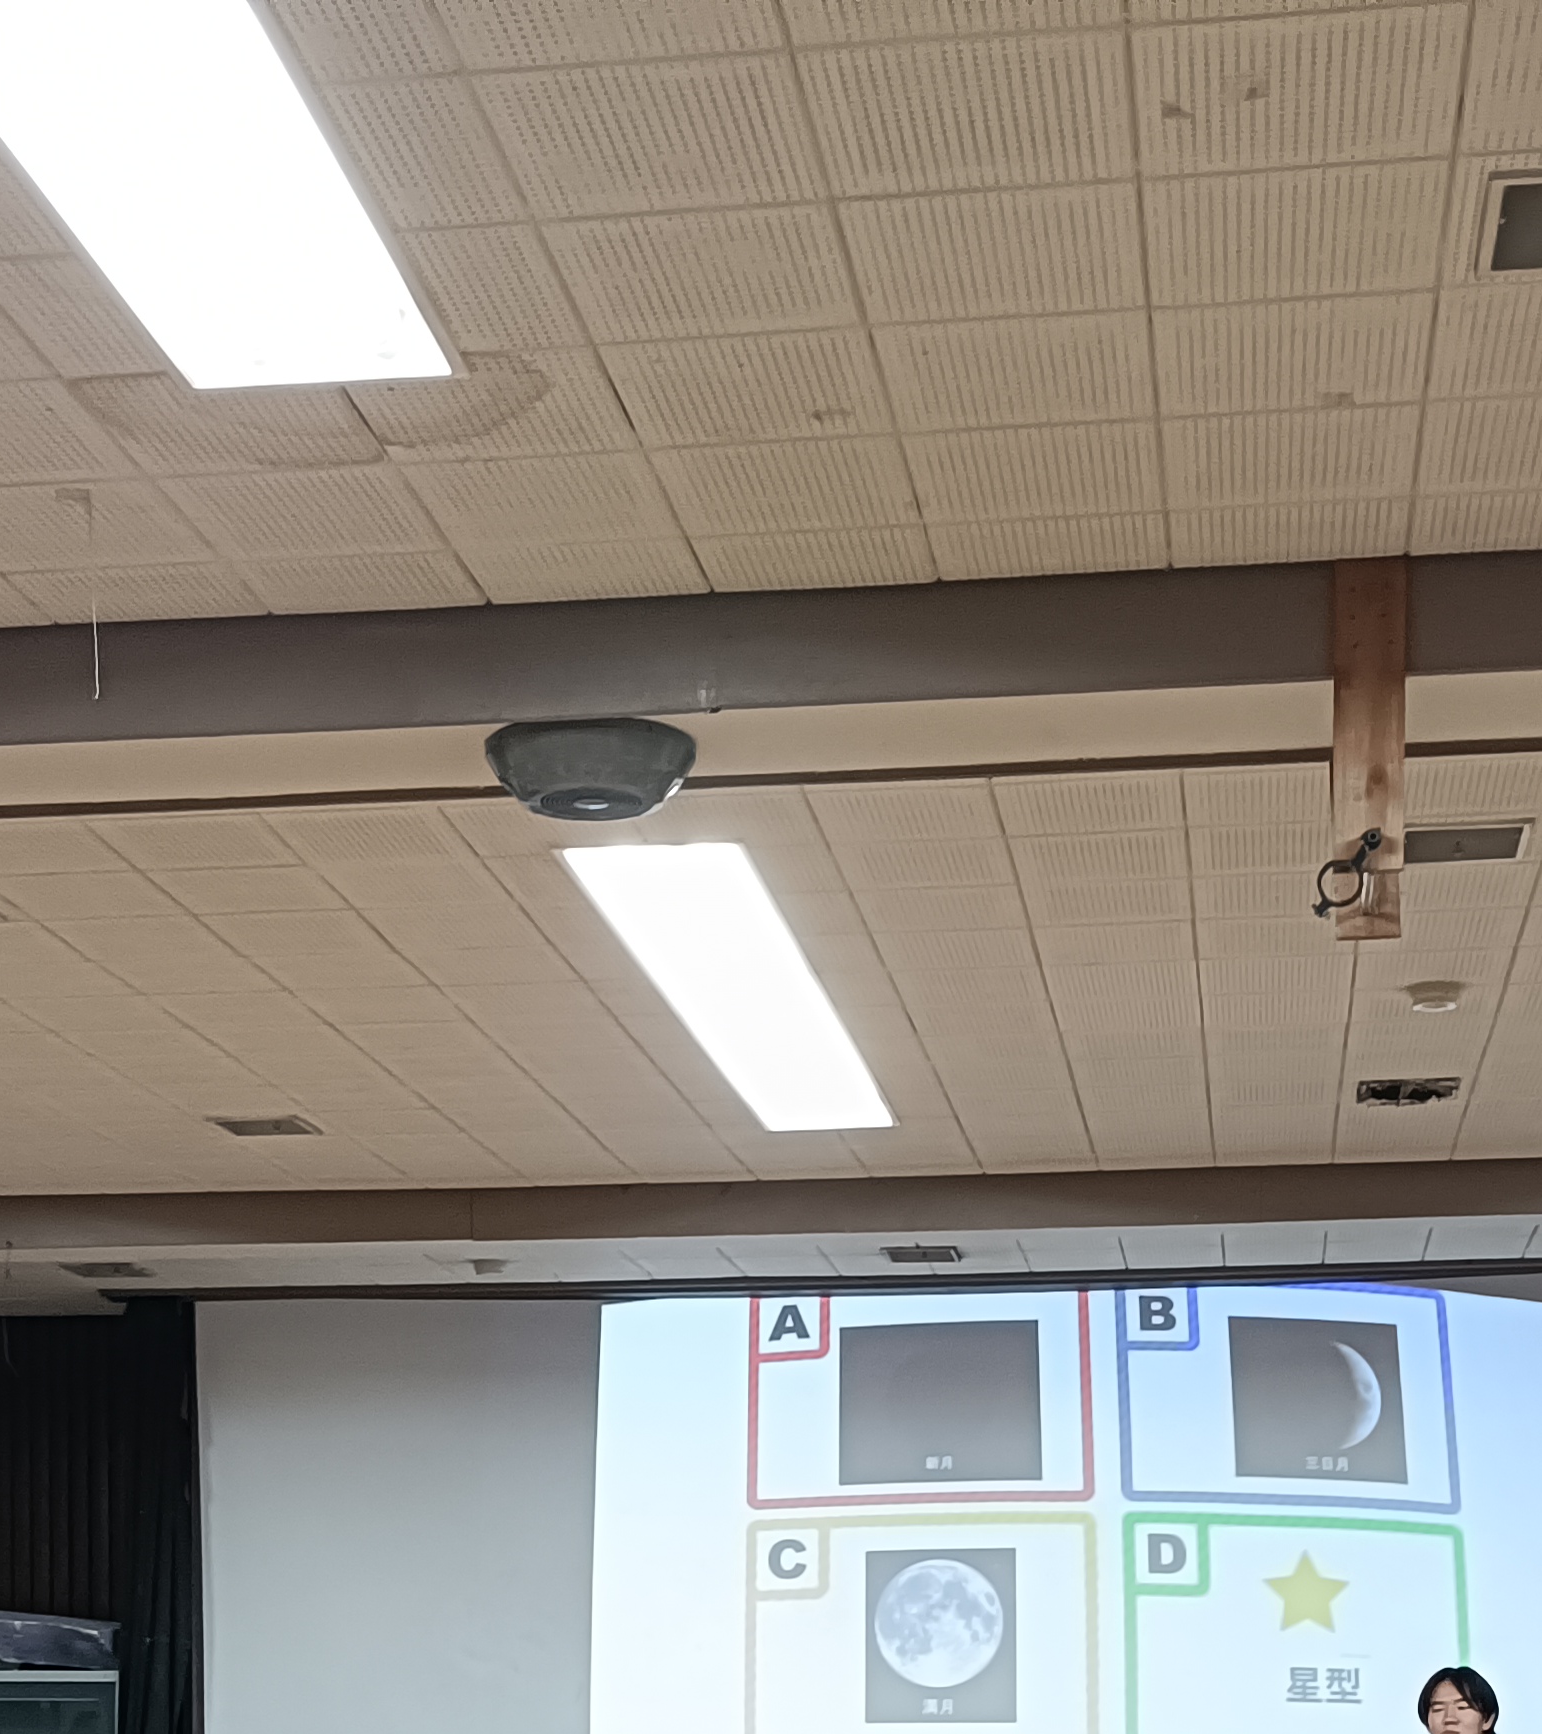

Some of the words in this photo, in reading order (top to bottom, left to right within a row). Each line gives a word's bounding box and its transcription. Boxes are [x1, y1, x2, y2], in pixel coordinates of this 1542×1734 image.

[768, 1304, 810, 1341] A
[1139, 1295, 1176, 1331] B
[768, 1539, 807, 1579] C
[1147, 1533, 1187, 1574] D
[1286, 1667, 1362, 1704] 星型
